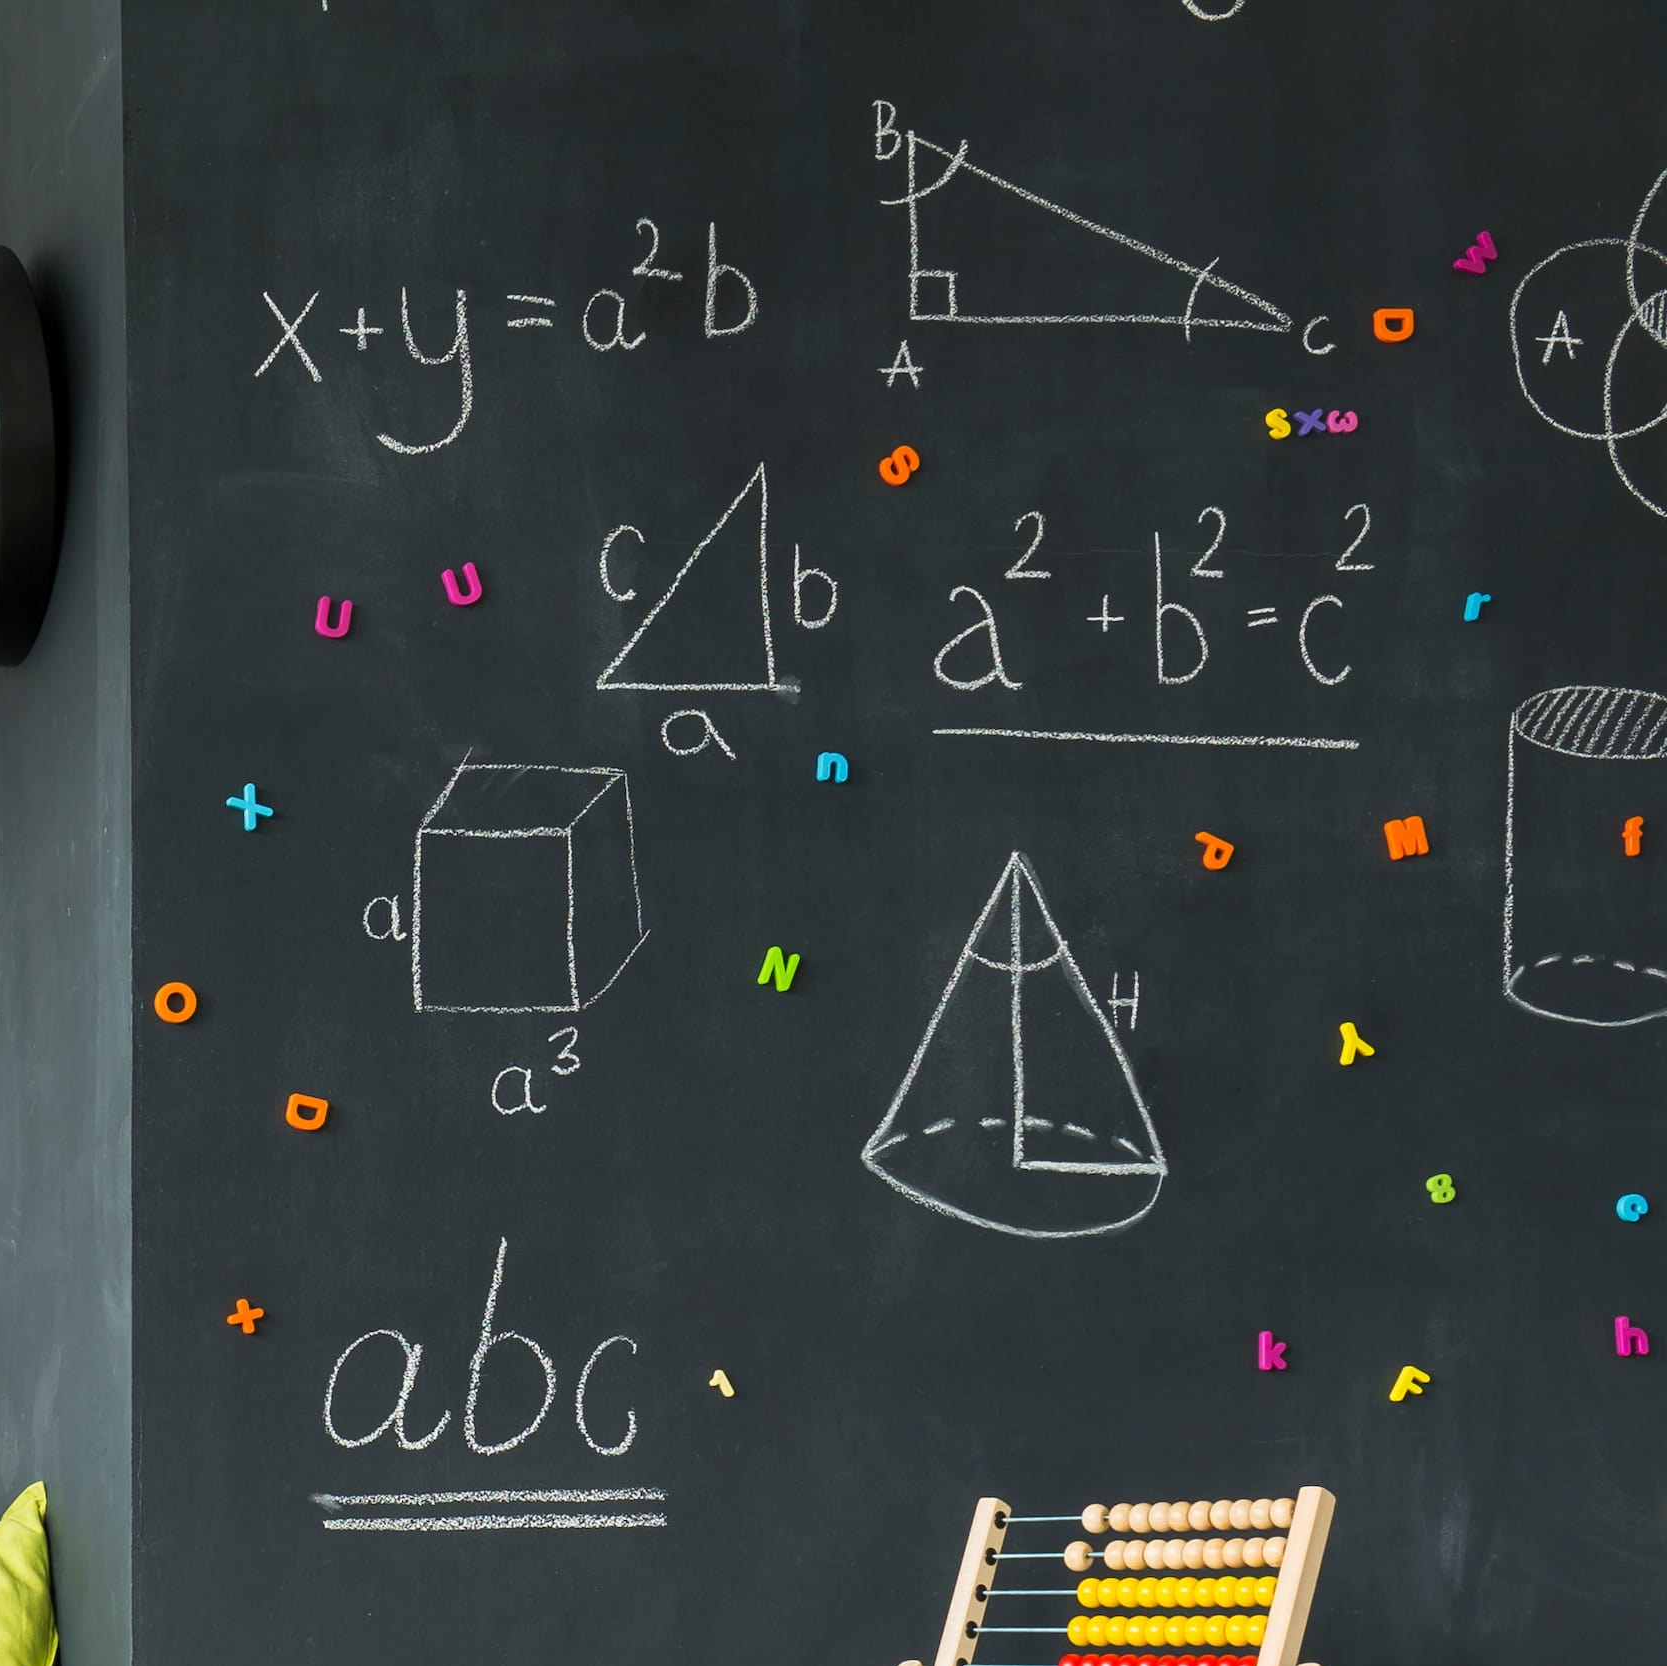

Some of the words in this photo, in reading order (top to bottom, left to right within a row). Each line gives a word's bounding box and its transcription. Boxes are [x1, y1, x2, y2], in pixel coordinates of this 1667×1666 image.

[872, 100, 903, 160] B
[1372, 307, 1415, 344] D
[1534, 309, 1585, 367] A
[877, 340, 924, 387] A
[794, 542, 839, 630] b
[661, 709, 737, 760] a
[1383, 815, 1430, 861] M
[1620, 815, 1645, 857] f
[362, 894, 407, 942] a
[1107, 971, 1141, 1031] H
[1616, 1193, 1650, 1223] e
[323, 1236, 638, 1457] abc
[1614, 1316, 1651, 1358] h
[1388, 1365, 1432, 1403] F
